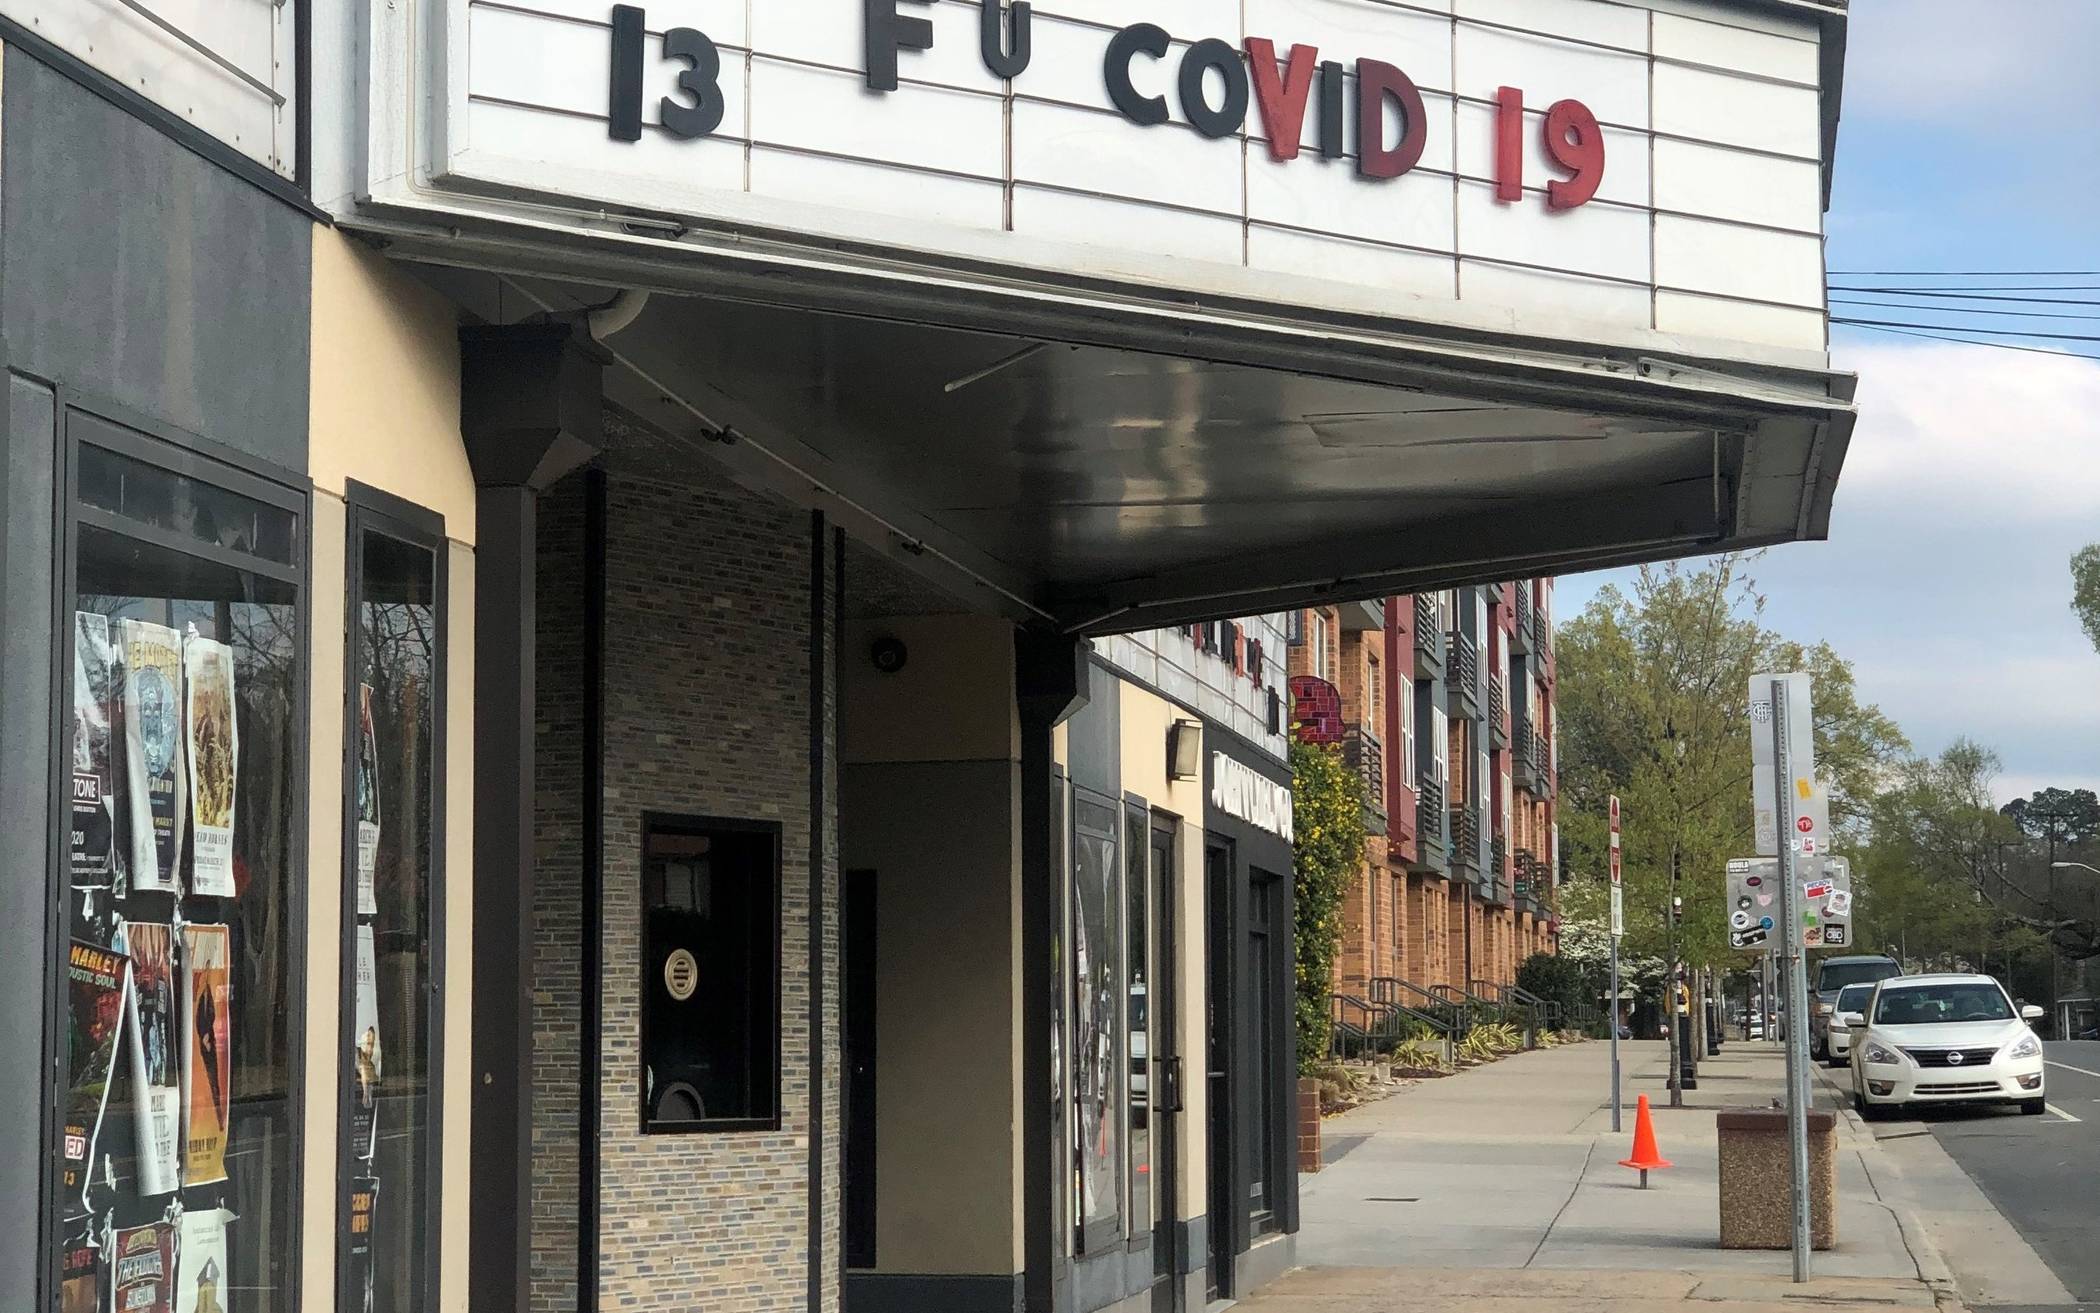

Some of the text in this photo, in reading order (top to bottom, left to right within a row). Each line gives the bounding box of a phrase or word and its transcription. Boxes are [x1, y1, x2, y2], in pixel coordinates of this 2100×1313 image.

[1104, 23, 1427, 179] COVID
[1498, 86, 1605, 209] 19
[71, 945, 121, 975] MARLEY
[95, 973, 116, 989] SOUL
